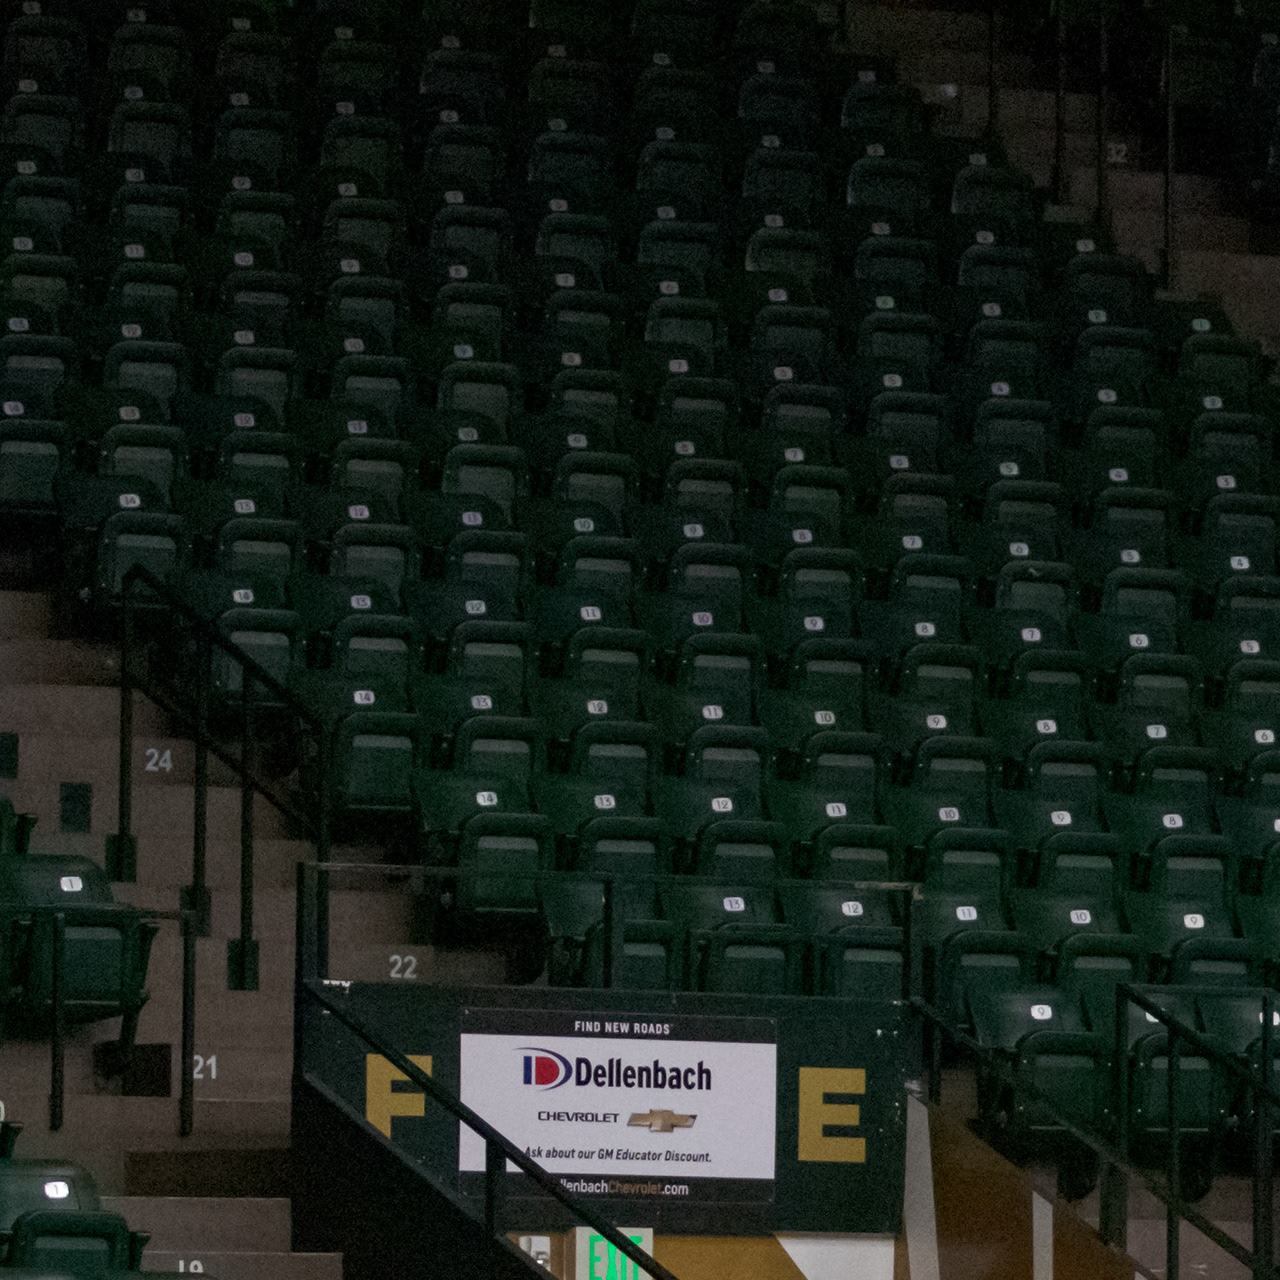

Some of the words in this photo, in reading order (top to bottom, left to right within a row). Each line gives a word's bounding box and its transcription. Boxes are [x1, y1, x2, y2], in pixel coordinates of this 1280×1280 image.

[358, 692, 371, 702] 14
[144, 748, 173, 772] 24
[716, 800, 728, 809] 12
[728, 899, 740, 909] 13
[847, 904, 859, 914] 12
[961, 908, 972, 918] 11
[1074, 912, 1088, 922] 10
[388, 955, 417, 979] 22
[574, 1021, 601, 1032] FIND
[605, 1022, 630, 1034] NEW
[633, 1023, 671, 1035] ROADS
[193, 1055, 218, 1079] 21
[575, 1057, 712, 1090] Dellenbach
[366, 1053, 433, 1138] F
[538, 1110, 620, 1123] CHEVROLET
[799, 1067, 866, 1163] E
[525, 1146, 543, 1159] Ask
[545, 1147, 575, 1159] about
[577, 1150, 594, 1159] our
[597, 1149, 614, 1160] GM
[615, 1149, 663, 1161] Educator
[664, 1150, 712, 1163] Discount.
